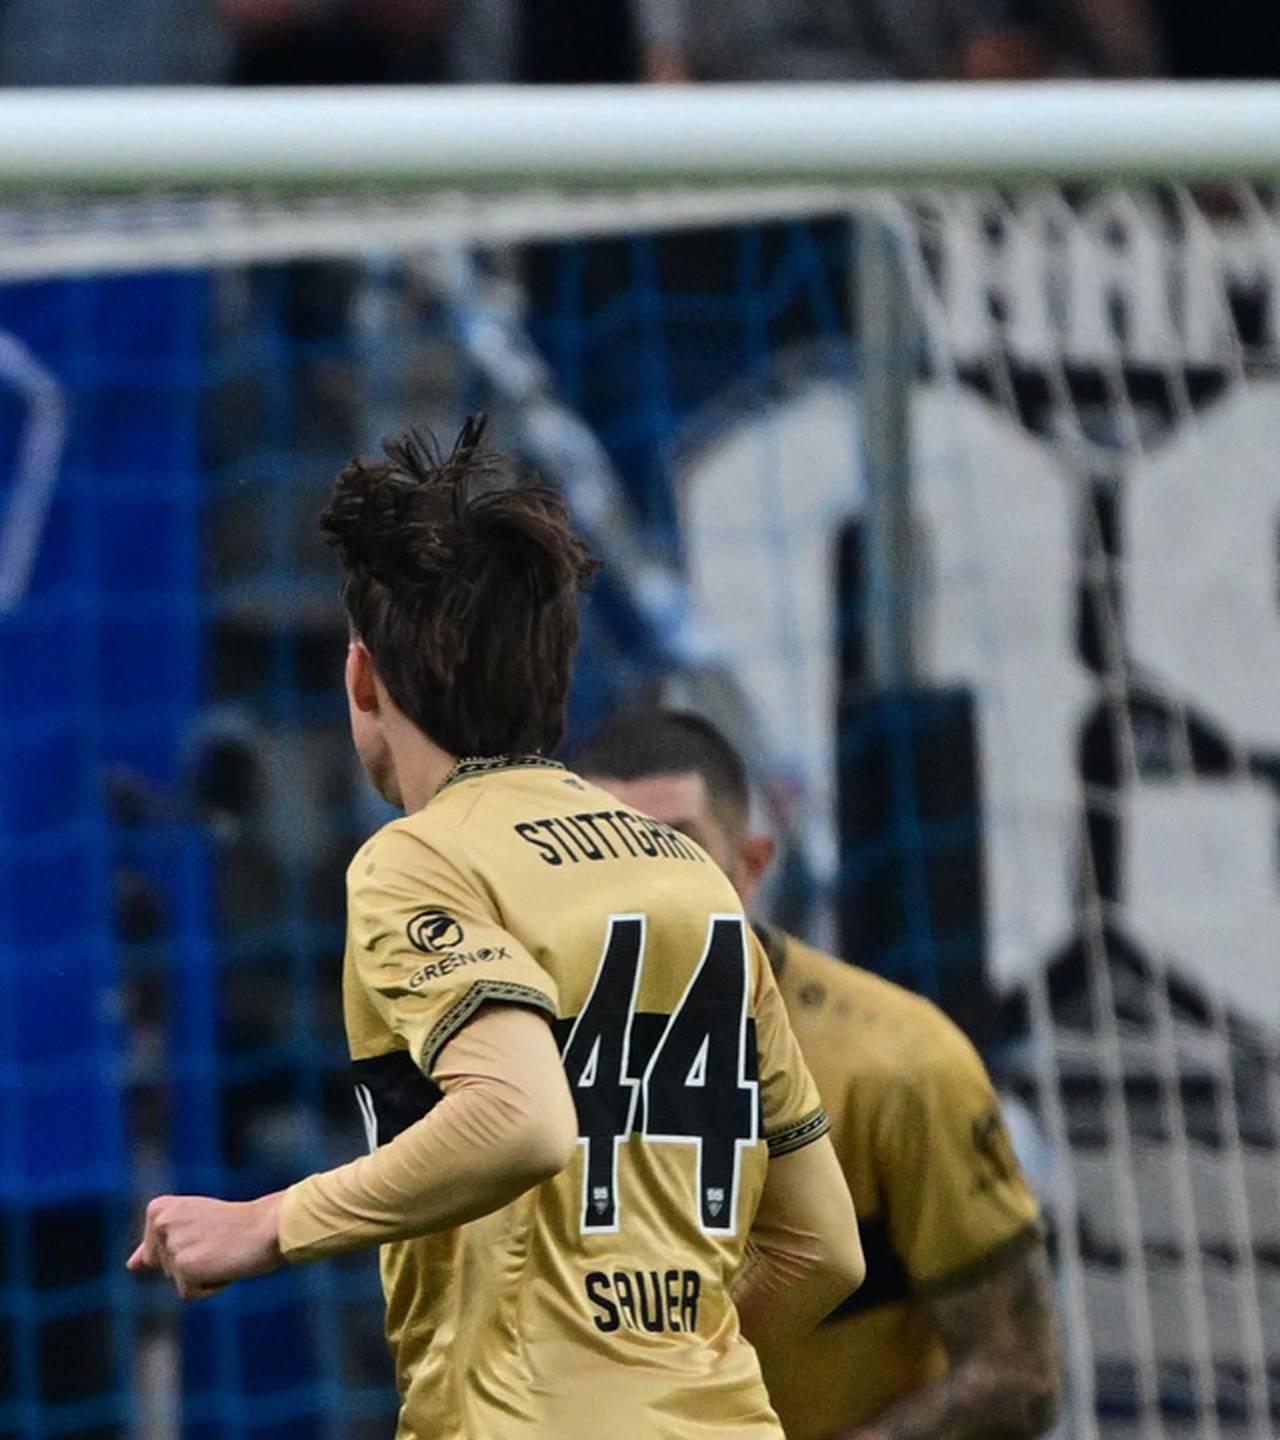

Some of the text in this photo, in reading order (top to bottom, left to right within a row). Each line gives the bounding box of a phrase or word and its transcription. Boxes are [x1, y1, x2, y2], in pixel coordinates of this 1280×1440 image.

[409, 946, 512, 988] GREENOX
[560, 913, 758, 1236] 44
[584, 1270, 701, 1333] SAUER
